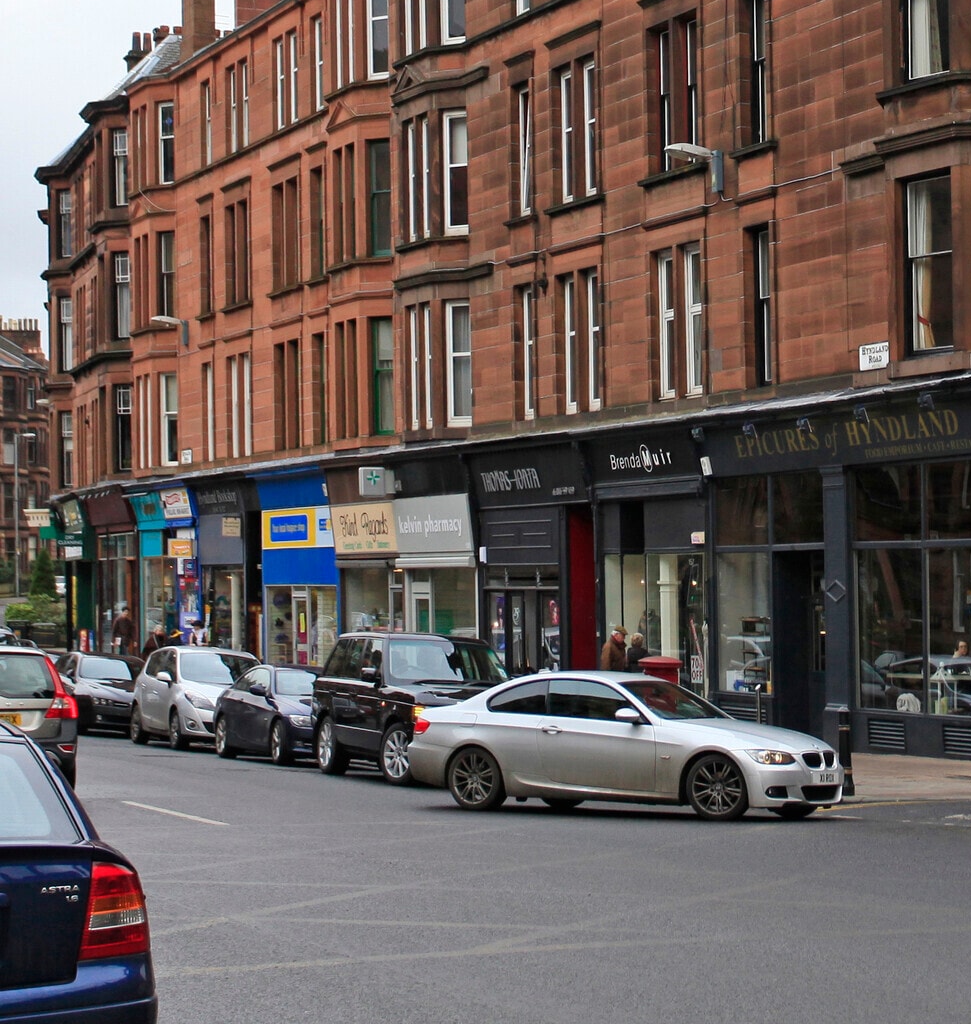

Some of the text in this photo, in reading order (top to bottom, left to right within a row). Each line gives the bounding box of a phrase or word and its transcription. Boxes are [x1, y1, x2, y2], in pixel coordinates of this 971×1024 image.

[868, 356, 882, 364] ROAD
[734, 409, 959, 458] EPICURES of HYNDLAND
[610, 454, 641, 470] Brenda
[399, 514, 462, 537] kelvin pharmacy
[40, 885, 80, 894] ASTRA
